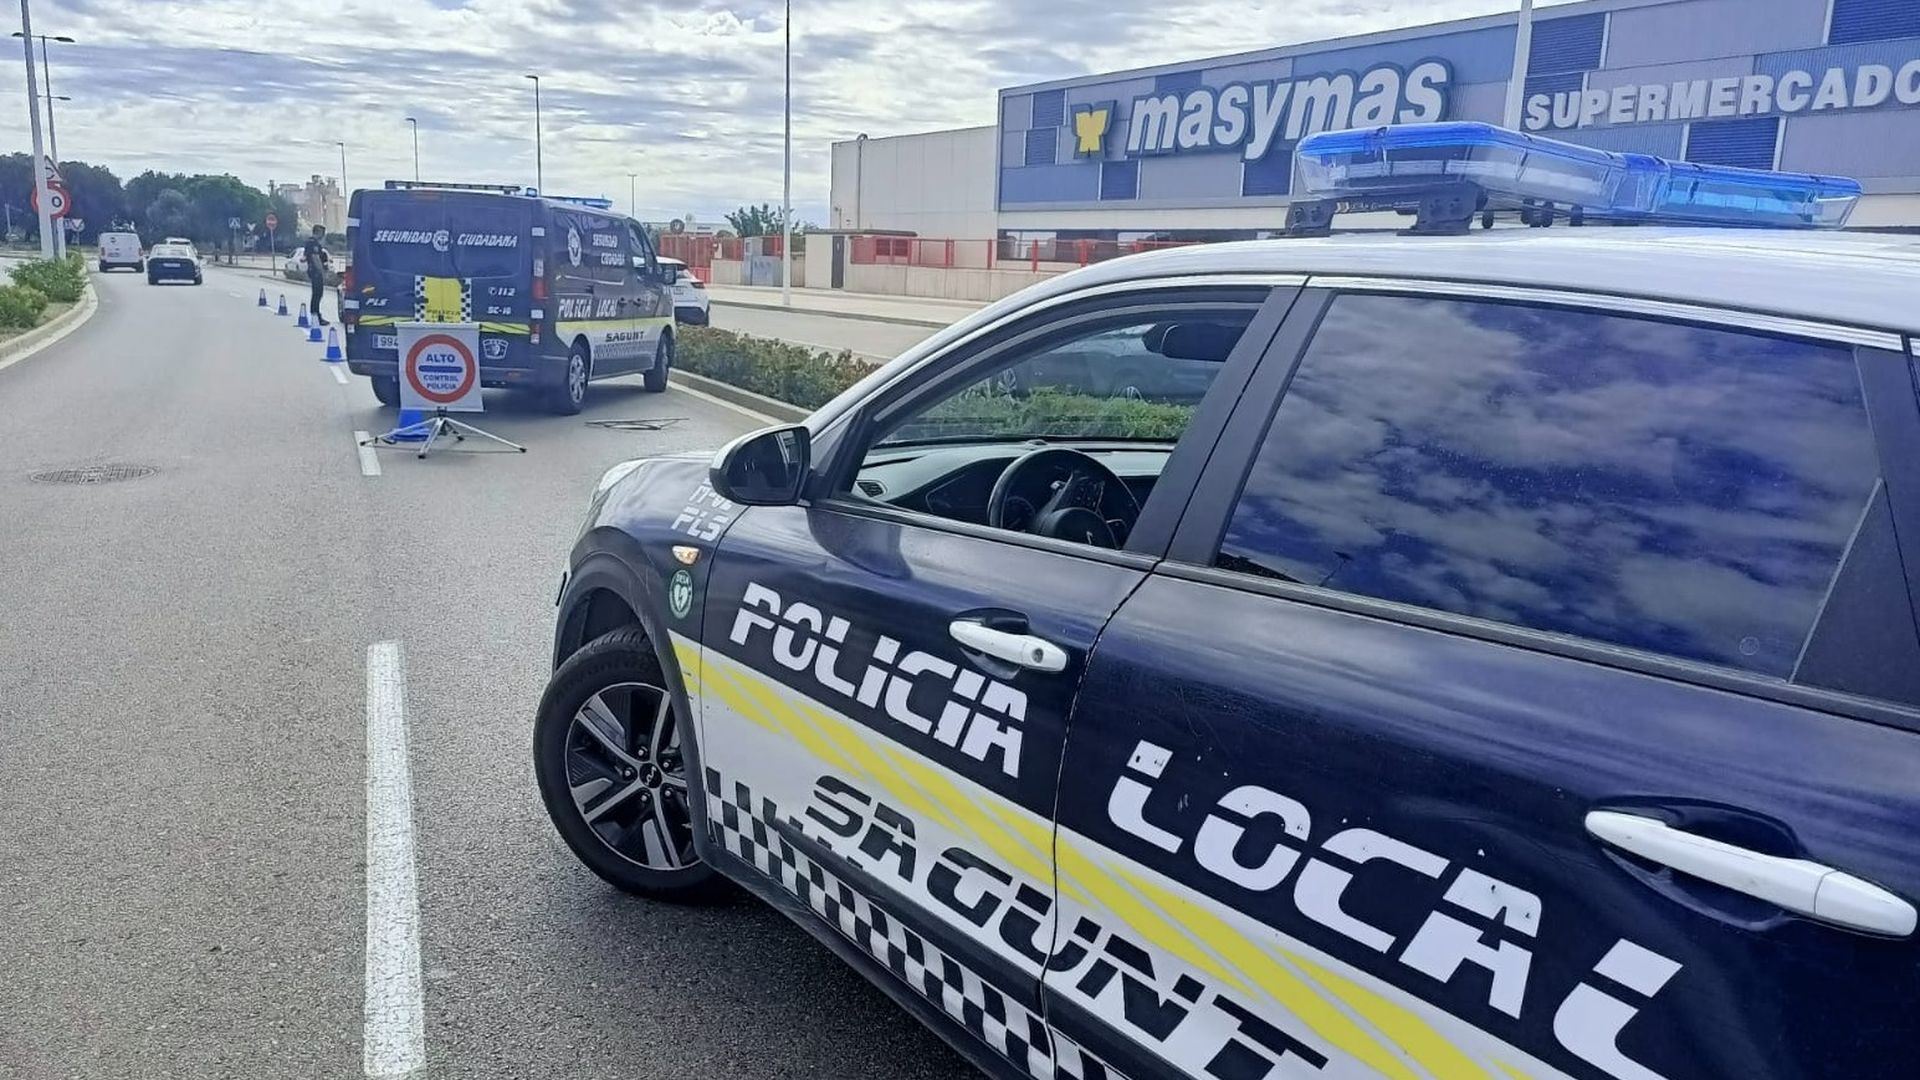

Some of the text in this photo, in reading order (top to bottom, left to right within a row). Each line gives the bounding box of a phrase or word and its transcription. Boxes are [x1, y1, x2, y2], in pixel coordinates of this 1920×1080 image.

[1525, 60, 1920, 130] SUPERMERCADO
[1127, 62, 1448, 160] masymas
[373, 229, 518, 248] SEGURIDAD CIUDADANA
[498, 287, 516, 297] 112
[558, 298, 593, 318] POLICIA
[604, 331, 645, 343] SAGUNT
[426, 353, 456, 363] ALTO
[423, 375, 459, 383] CONTROL
[670, 505, 730, 542] PLS
[729, 581, 1683, 1080] POLICIA LOCAL
[805, 775, 1330, 1080] SAGUNT
